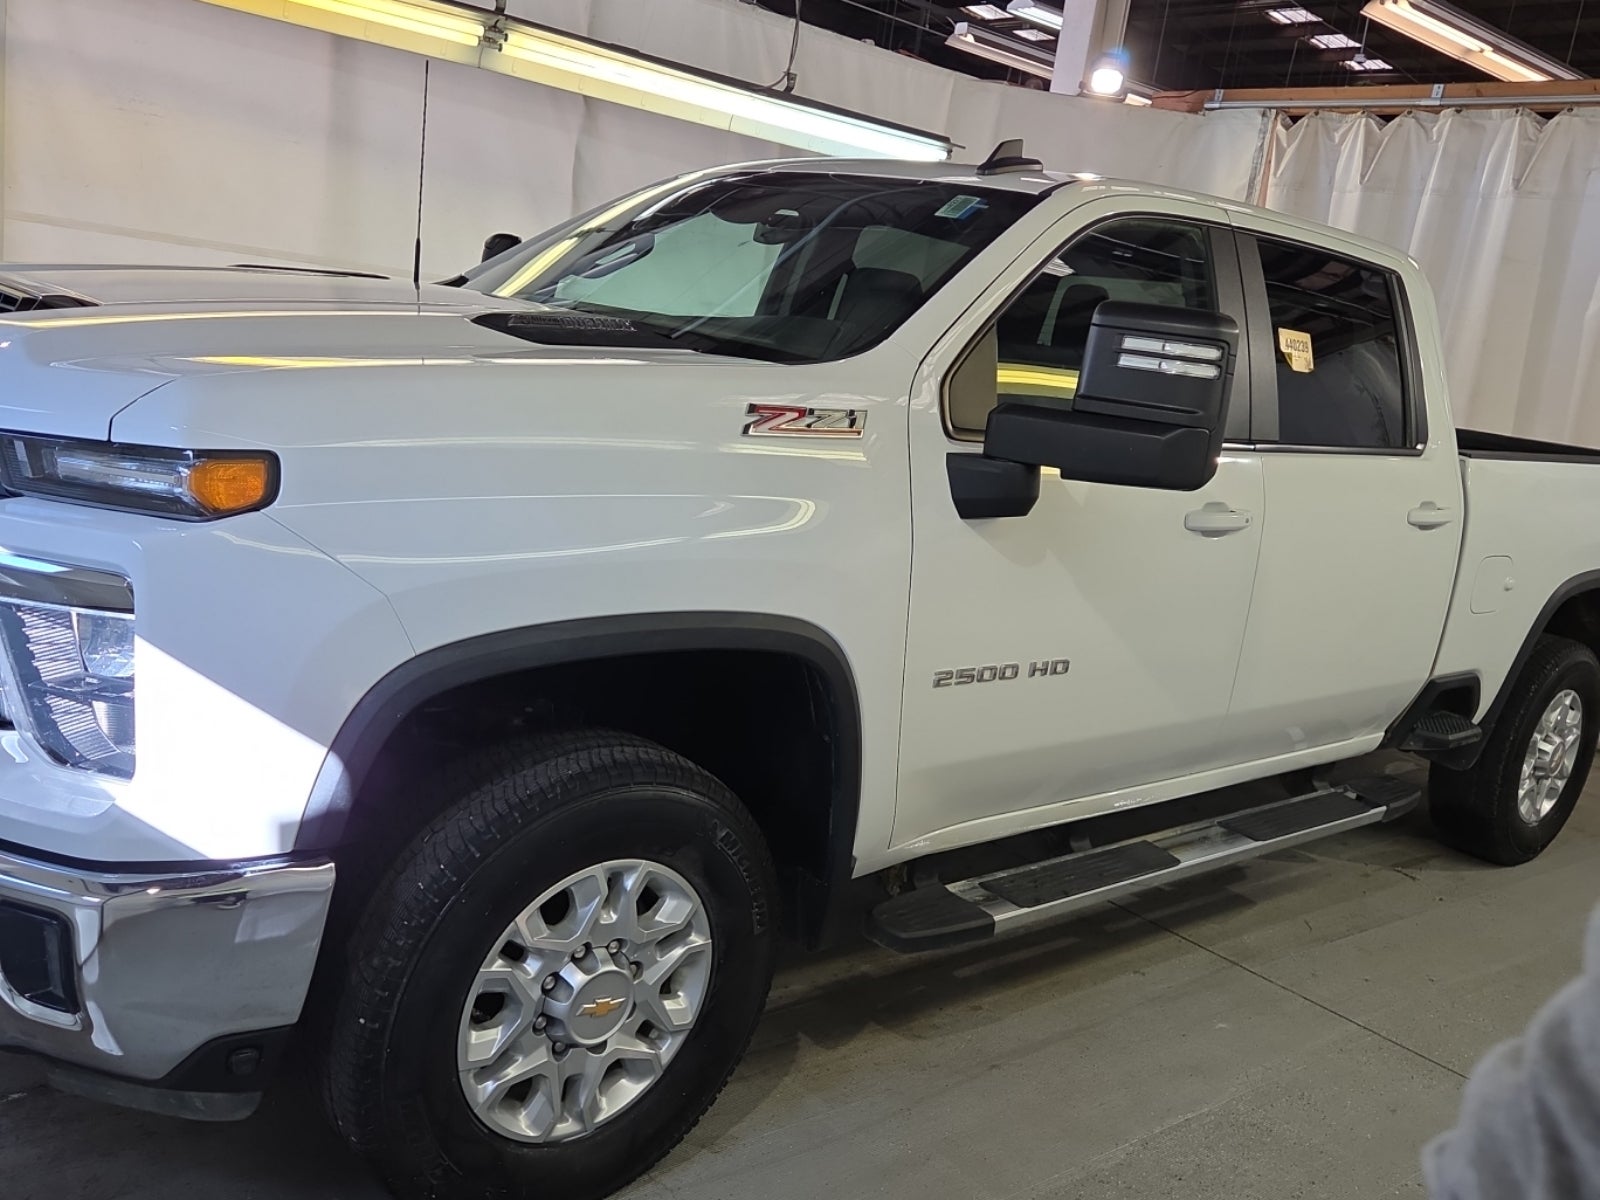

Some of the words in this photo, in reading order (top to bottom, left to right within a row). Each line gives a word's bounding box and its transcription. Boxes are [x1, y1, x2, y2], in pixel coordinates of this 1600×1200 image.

[741, 402, 868, 438] Z71
[932, 662, 1020, 689] 2500
[1027, 658, 1071, 679] HD
